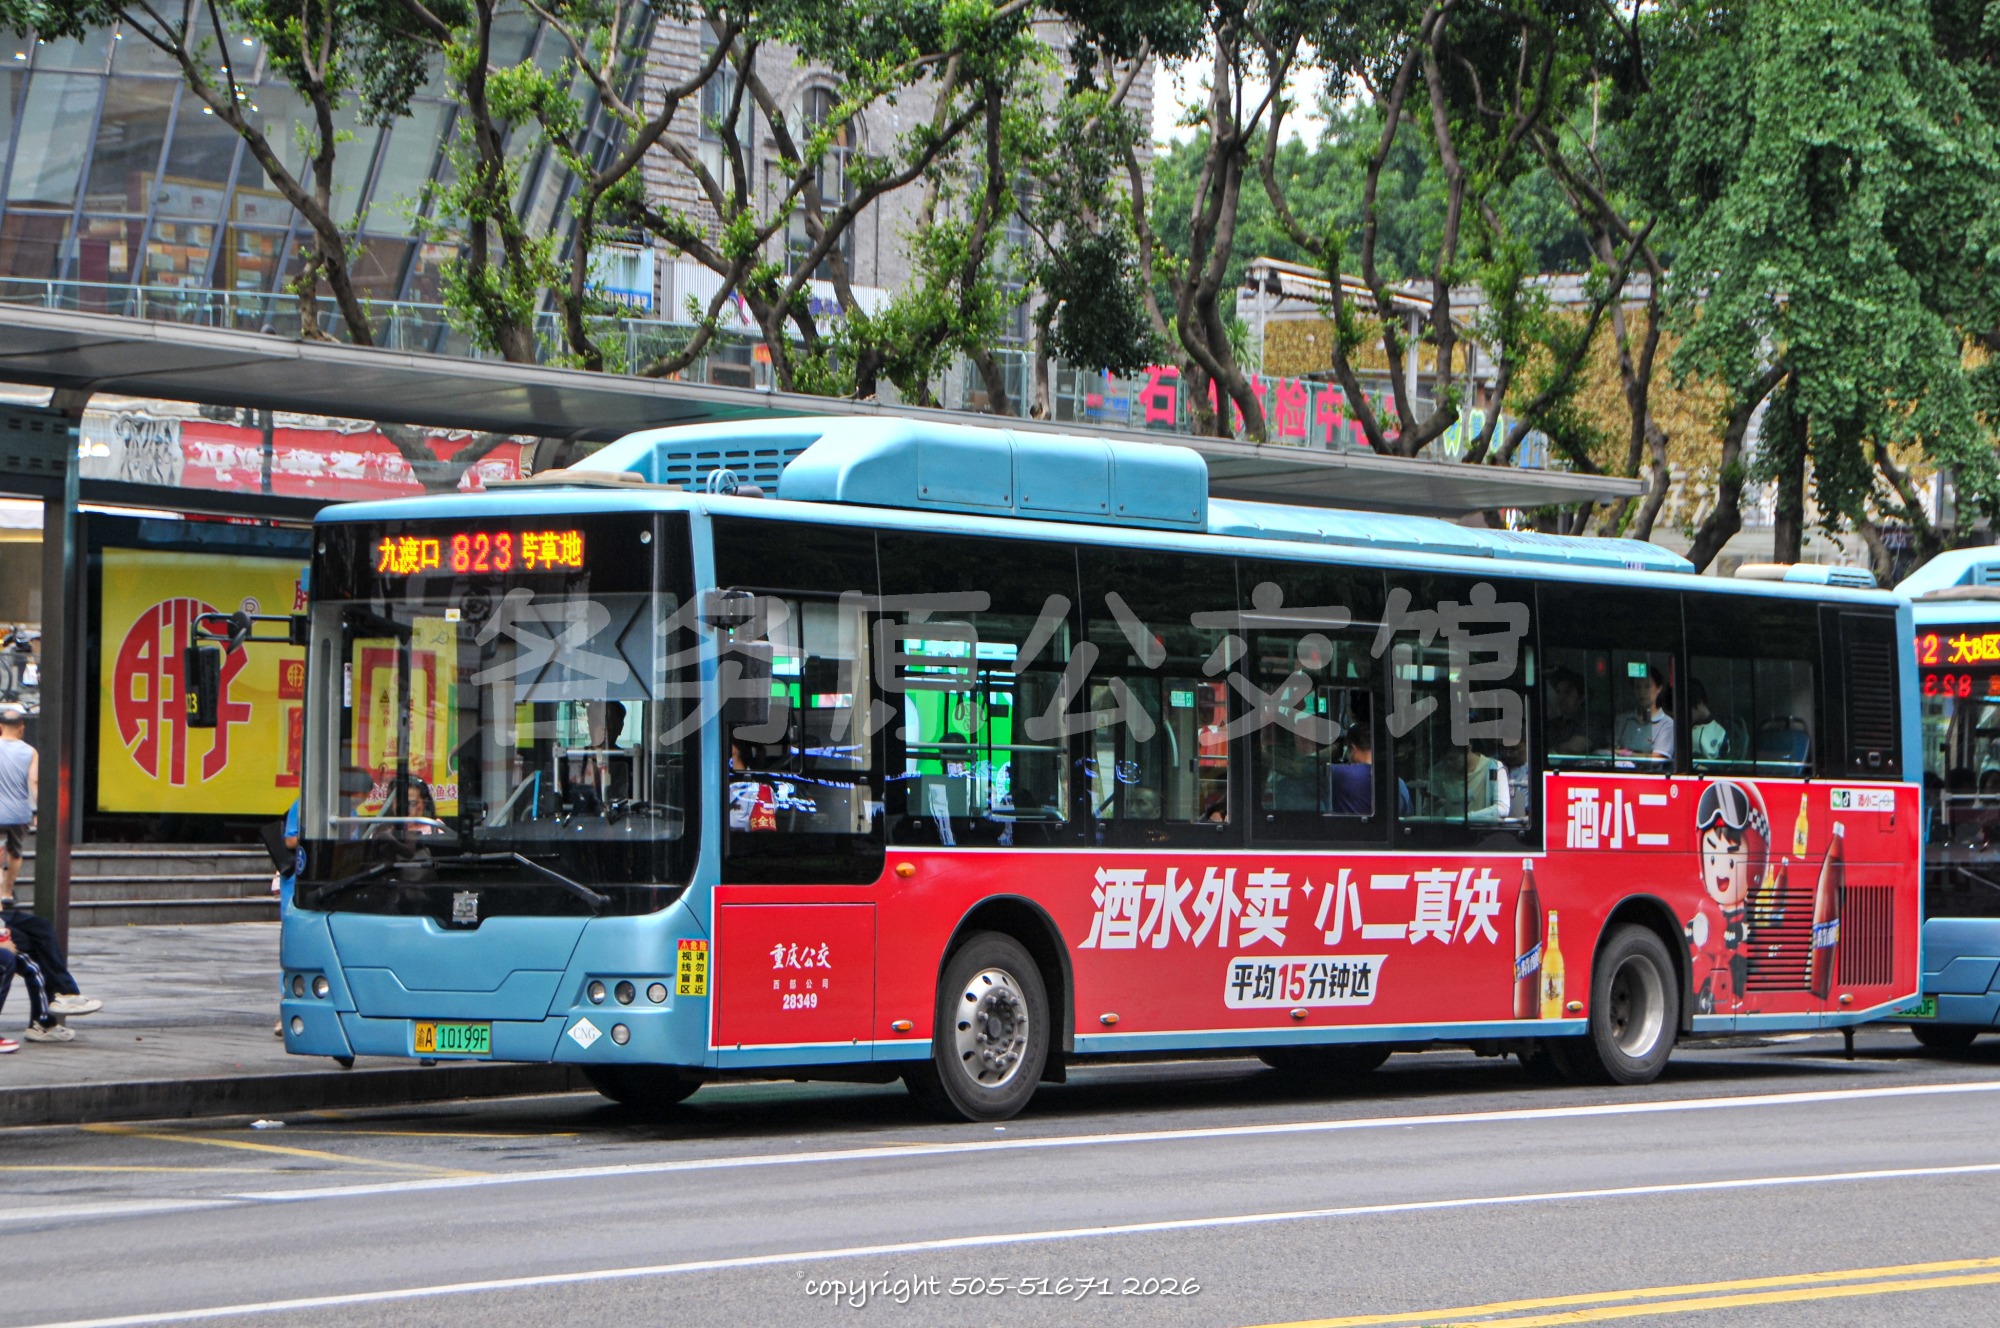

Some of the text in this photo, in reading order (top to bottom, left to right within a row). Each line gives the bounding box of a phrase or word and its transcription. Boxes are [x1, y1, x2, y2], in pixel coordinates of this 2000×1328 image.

[378, 536, 440, 573] 九渡口
[452, 532, 512, 572] 823
[1566, 787, 1670, 849] 酒小二
[1077, 866, 1502, 950] 酒水外卖 小二真快
[681, 951, 693, 994] 视线盲区
[694, 951, 705, 995] 请勿靠近
[769, 942, 832, 970] 重庆公交
[772, 978, 830, 991] 西部公司
[782, 993, 819, 1010] 28349
[1231, 962, 1372, 1002] 平均15分钟达
[572, 1026, 596, 1041] CNG
